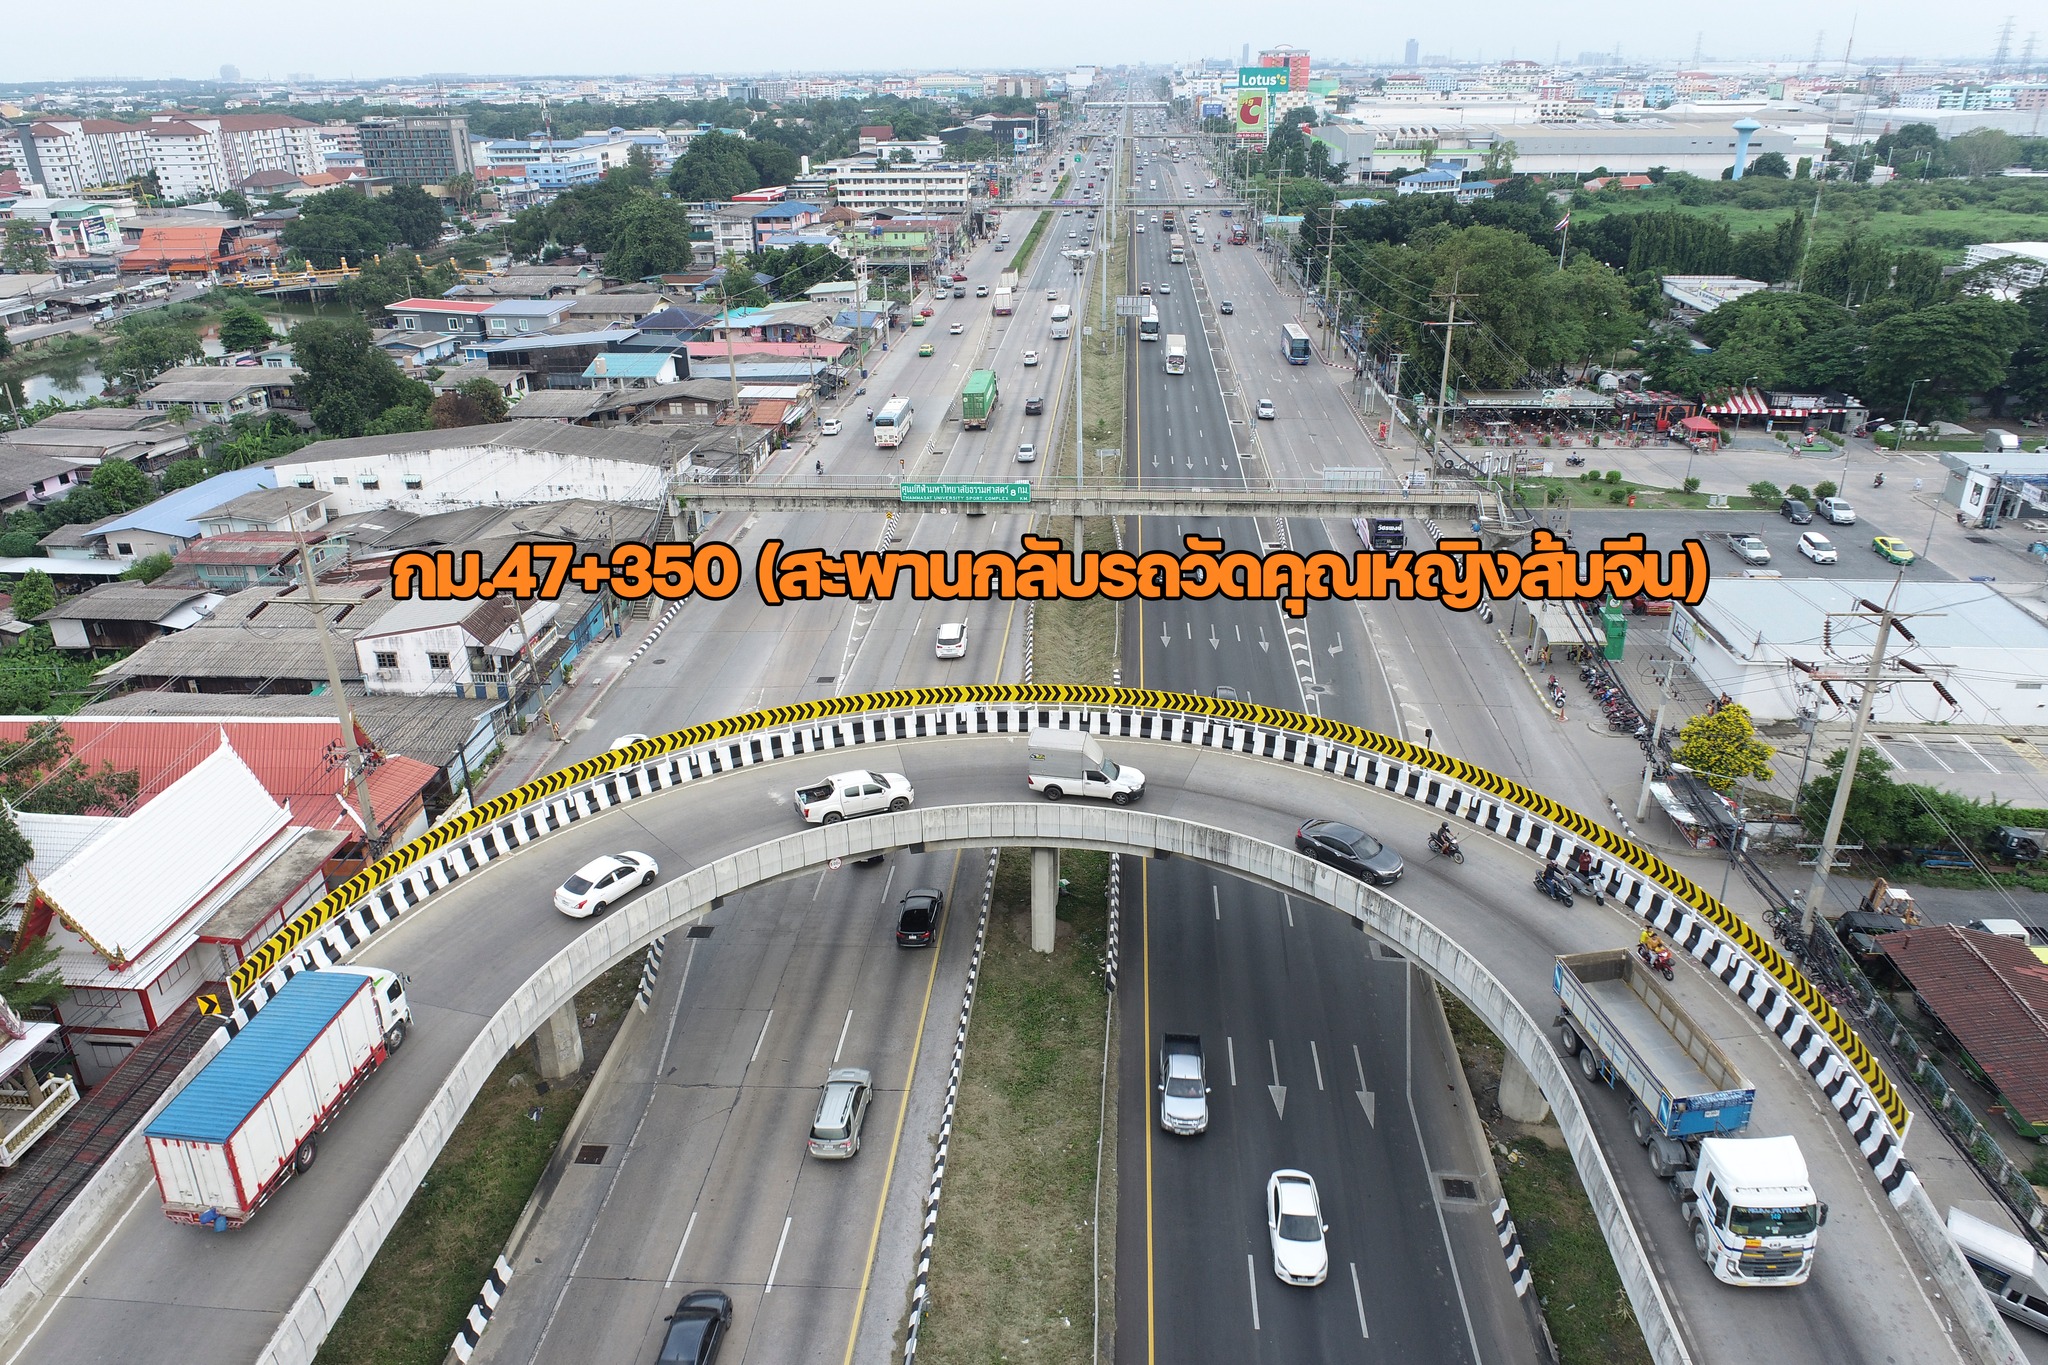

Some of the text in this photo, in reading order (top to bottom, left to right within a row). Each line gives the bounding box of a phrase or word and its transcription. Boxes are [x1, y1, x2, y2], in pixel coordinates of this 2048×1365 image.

[1242, 74, 1287, 86] Lotus's
[1240, 96, 1263, 126] C
[1010, 488, 1017, 497] 8
